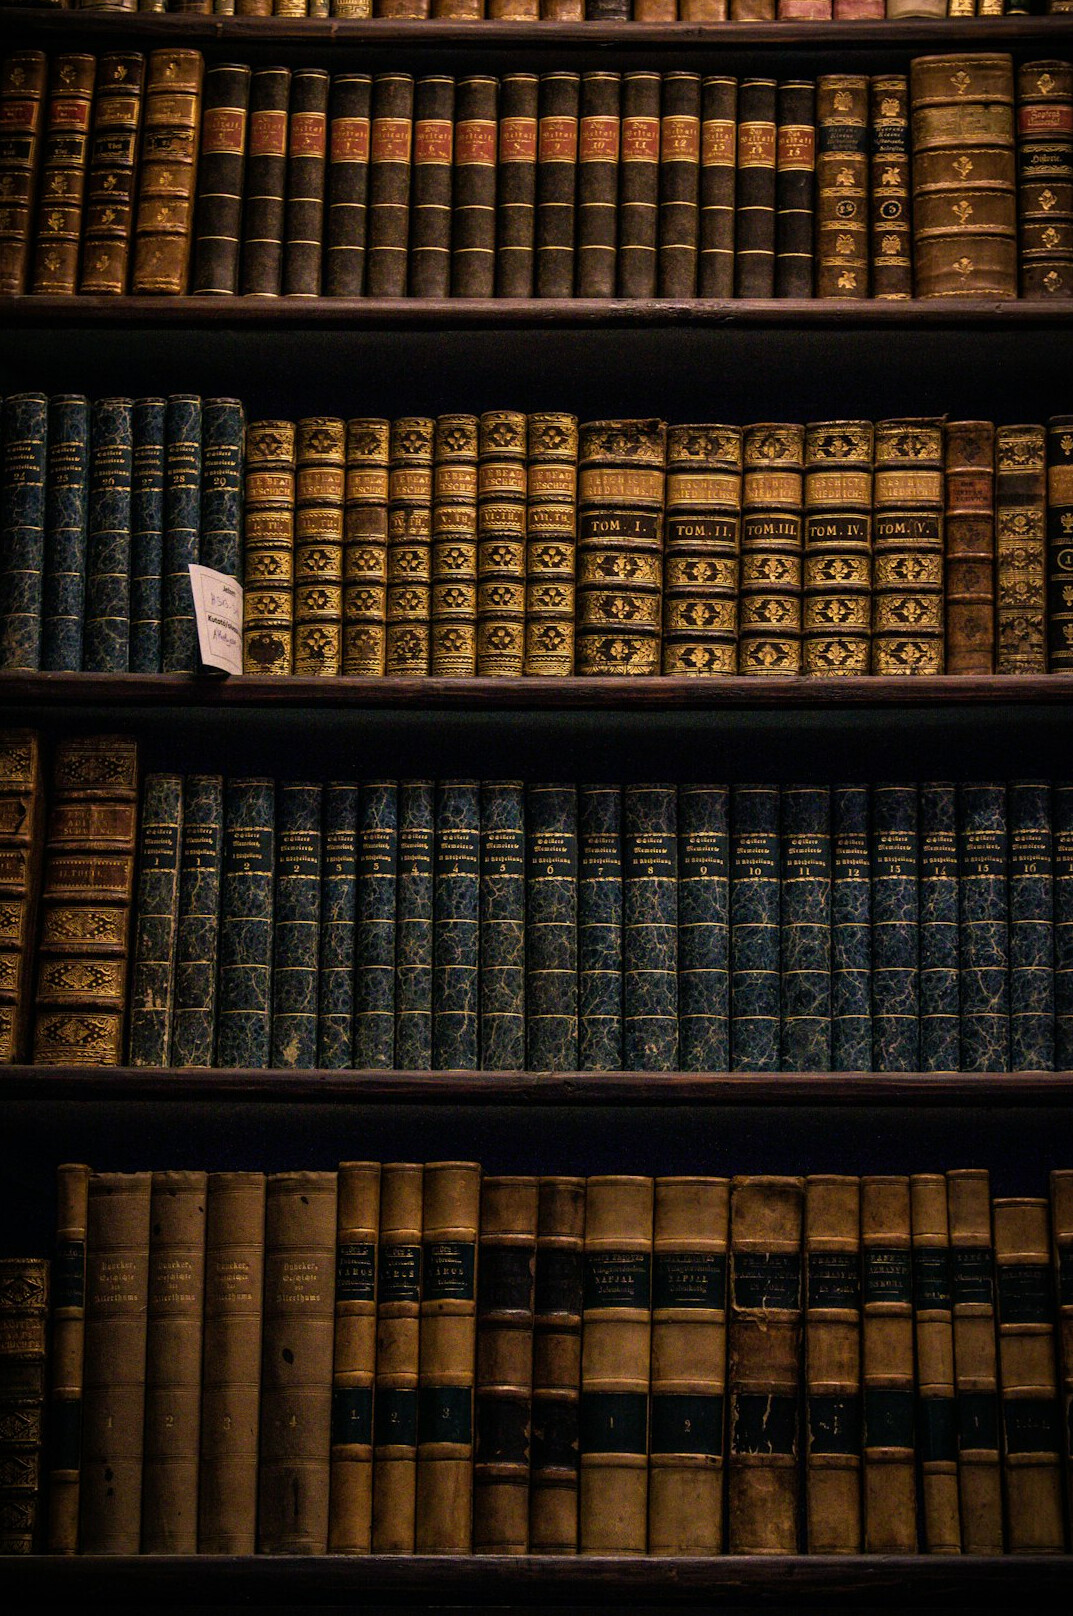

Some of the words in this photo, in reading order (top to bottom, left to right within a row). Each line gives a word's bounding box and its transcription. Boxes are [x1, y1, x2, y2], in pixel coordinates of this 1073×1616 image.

[173, 475, 185, 484] 28
[213, 477, 227, 487] 29
[590, 521, 627, 533] TOM.
[634, 521, 647, 533] I.
[676, 525, 712, 537] TOM.
[714, 526, 732, 537] II.
[747, 523, 779, 536] TOM.
[779, 523, 797, 535] III.
[810, 525, 843, 537] TOM.
[846, 525, 864, 536] IV.
[879, 522, 911, 535] TOM.
[917, 522, 931, 534] V.
[154, 857, 160, 866] 1
[195, 857, 201, 866] 1
[243, 862, 250, 870] 2
[293, 864, 301, 873] 2
[452, 863, 460, 873] 4
[546, 864, 555, 875] 6
[598, 867, 604, 876] 7
[647, 865, 655, 875] 8
[699, 865, 709, 876] 9
[748, 866, 762, 876] 10
[799, 867, 811, 876] 11
[848, 868, 861, 877] 12
[934, 866, 947, 876] 14
[1023, 863, 1037, 873] 16
